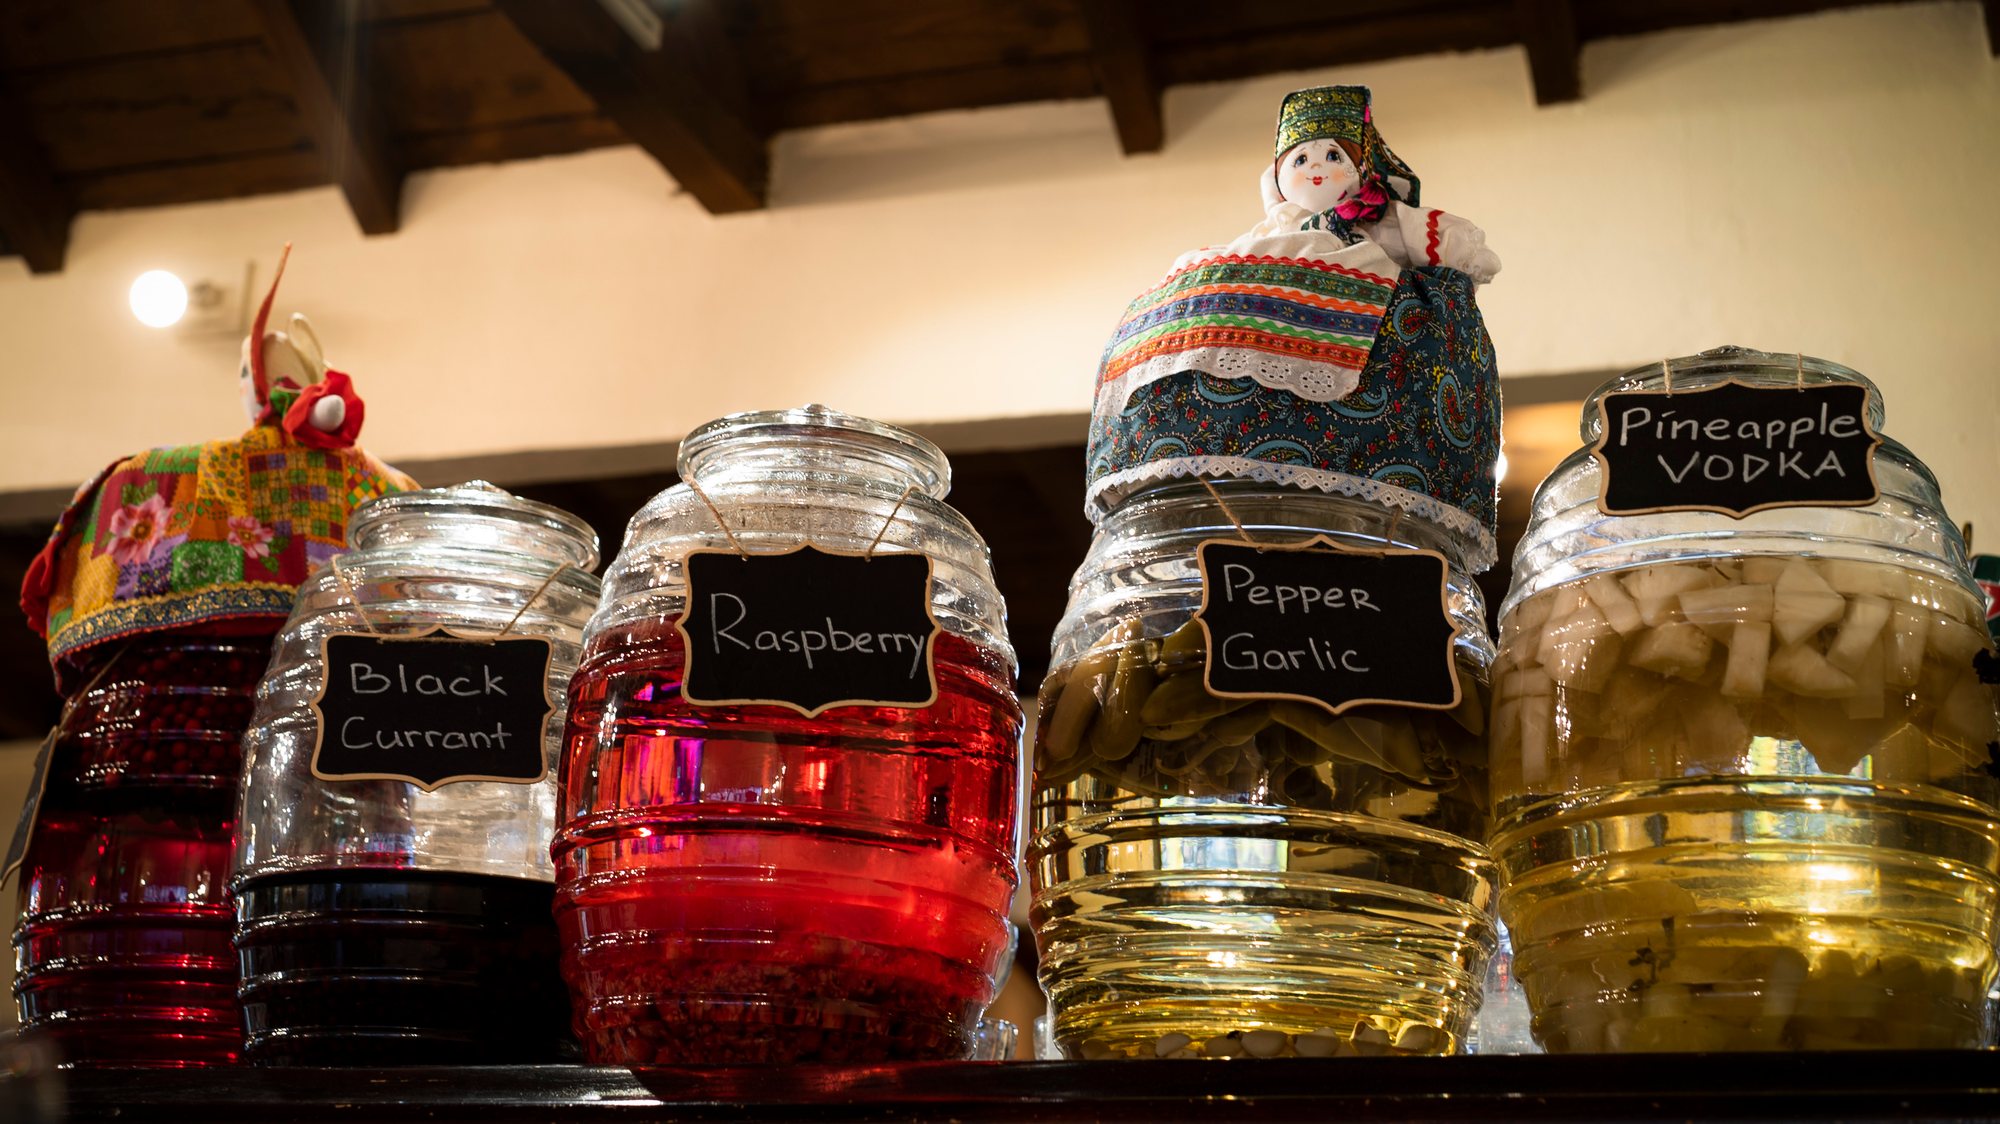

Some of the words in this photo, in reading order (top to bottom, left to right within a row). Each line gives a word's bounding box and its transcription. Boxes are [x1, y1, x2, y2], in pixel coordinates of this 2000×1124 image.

[1619, 402, 1862, 449] Pineapple
[1657, 450, 1846, 484] VODKA
[710, 592, 925, 679] Raspberry
[1222, 632, 1371, 673] Garlic
[350, 662, 508, 697] Black
[341, 716, 513, 750] Currant
